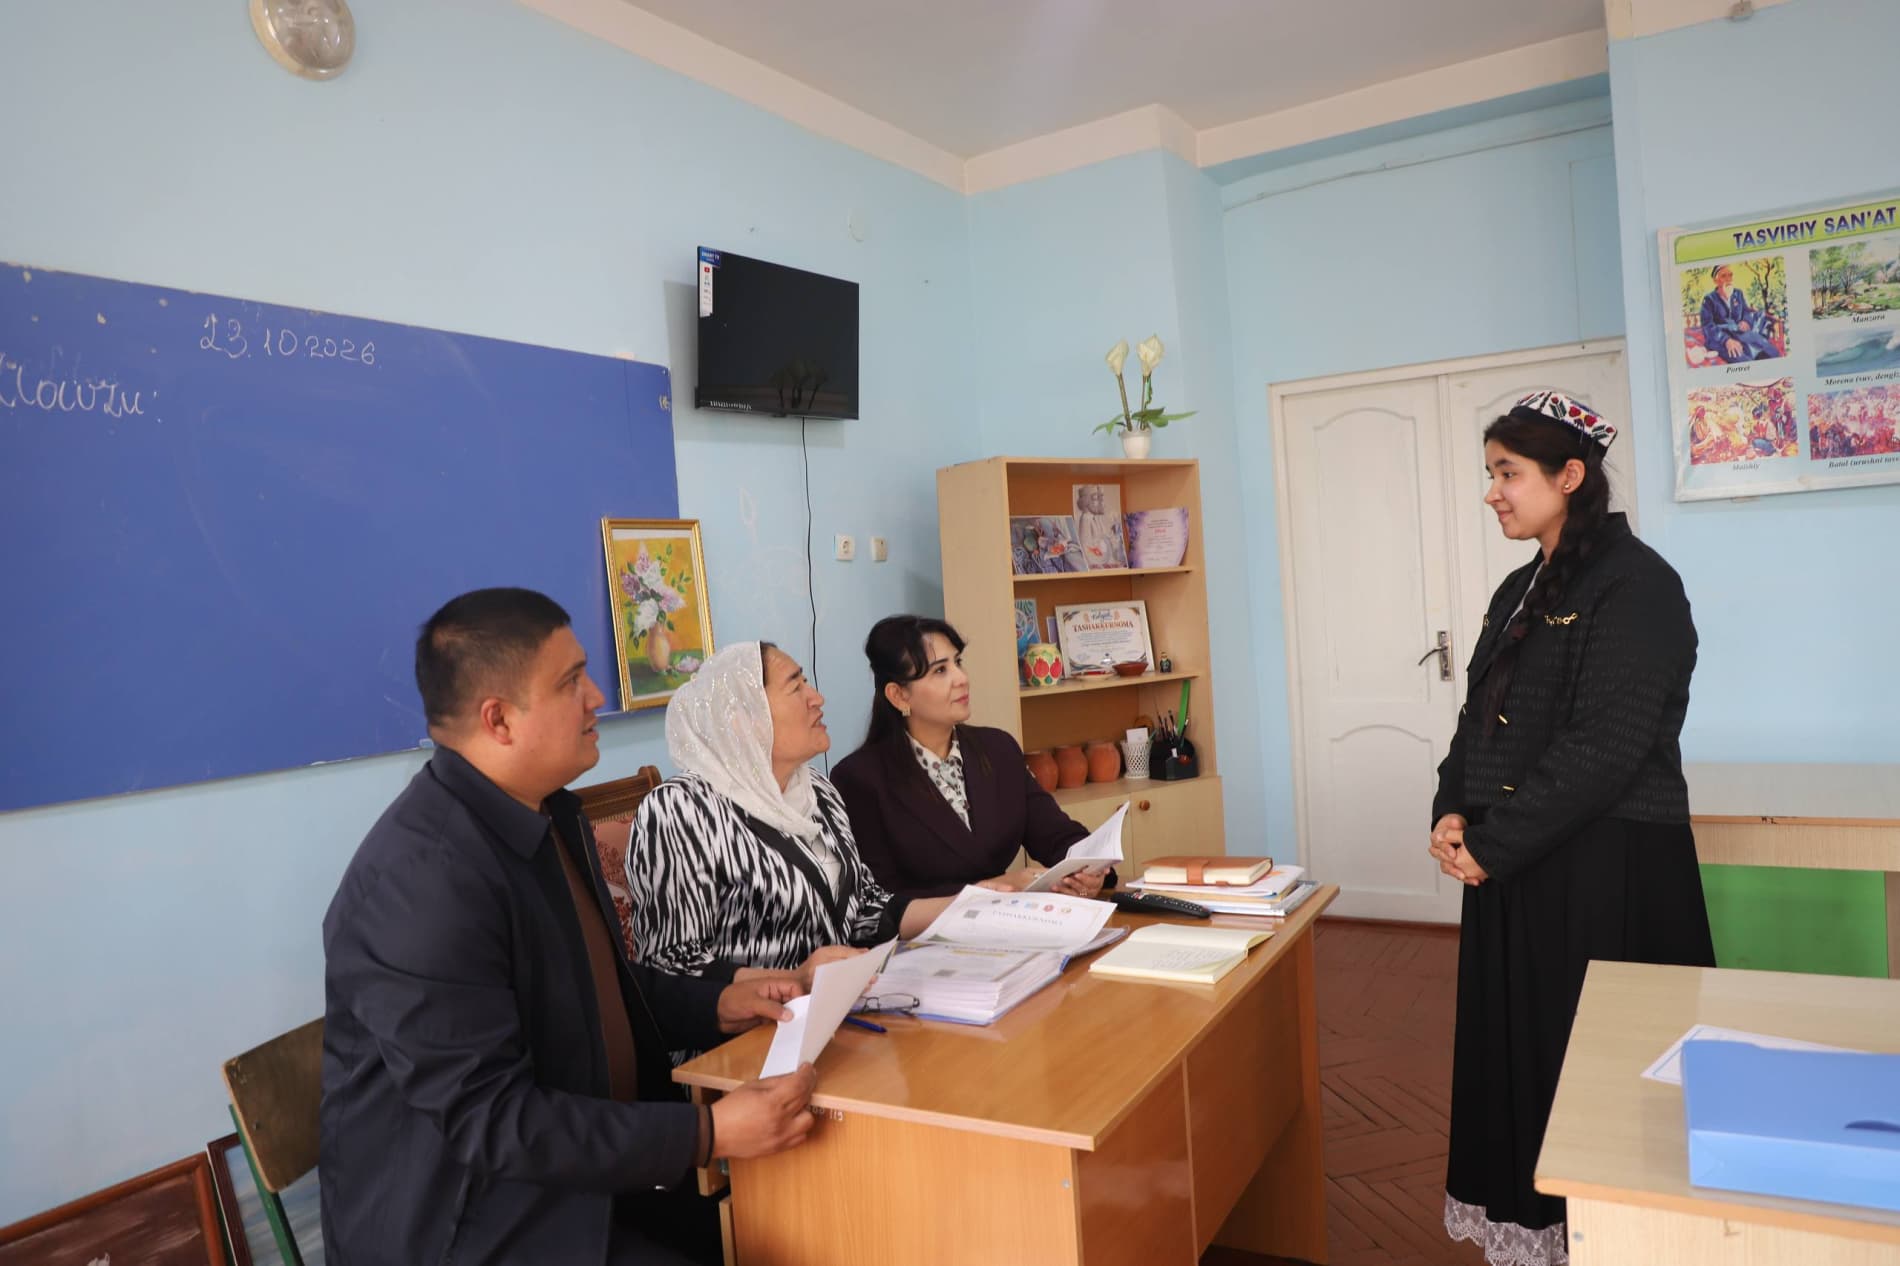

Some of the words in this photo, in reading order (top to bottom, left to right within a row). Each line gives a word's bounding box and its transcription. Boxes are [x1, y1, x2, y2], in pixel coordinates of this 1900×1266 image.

[1733, 220, 1817, 249] TASVIRIY
[1824, 206, 1897, 234] SAN'AT
[1852, 313, 1885, 323] Manzara
[1726, 365, 1750, 374] Portret
